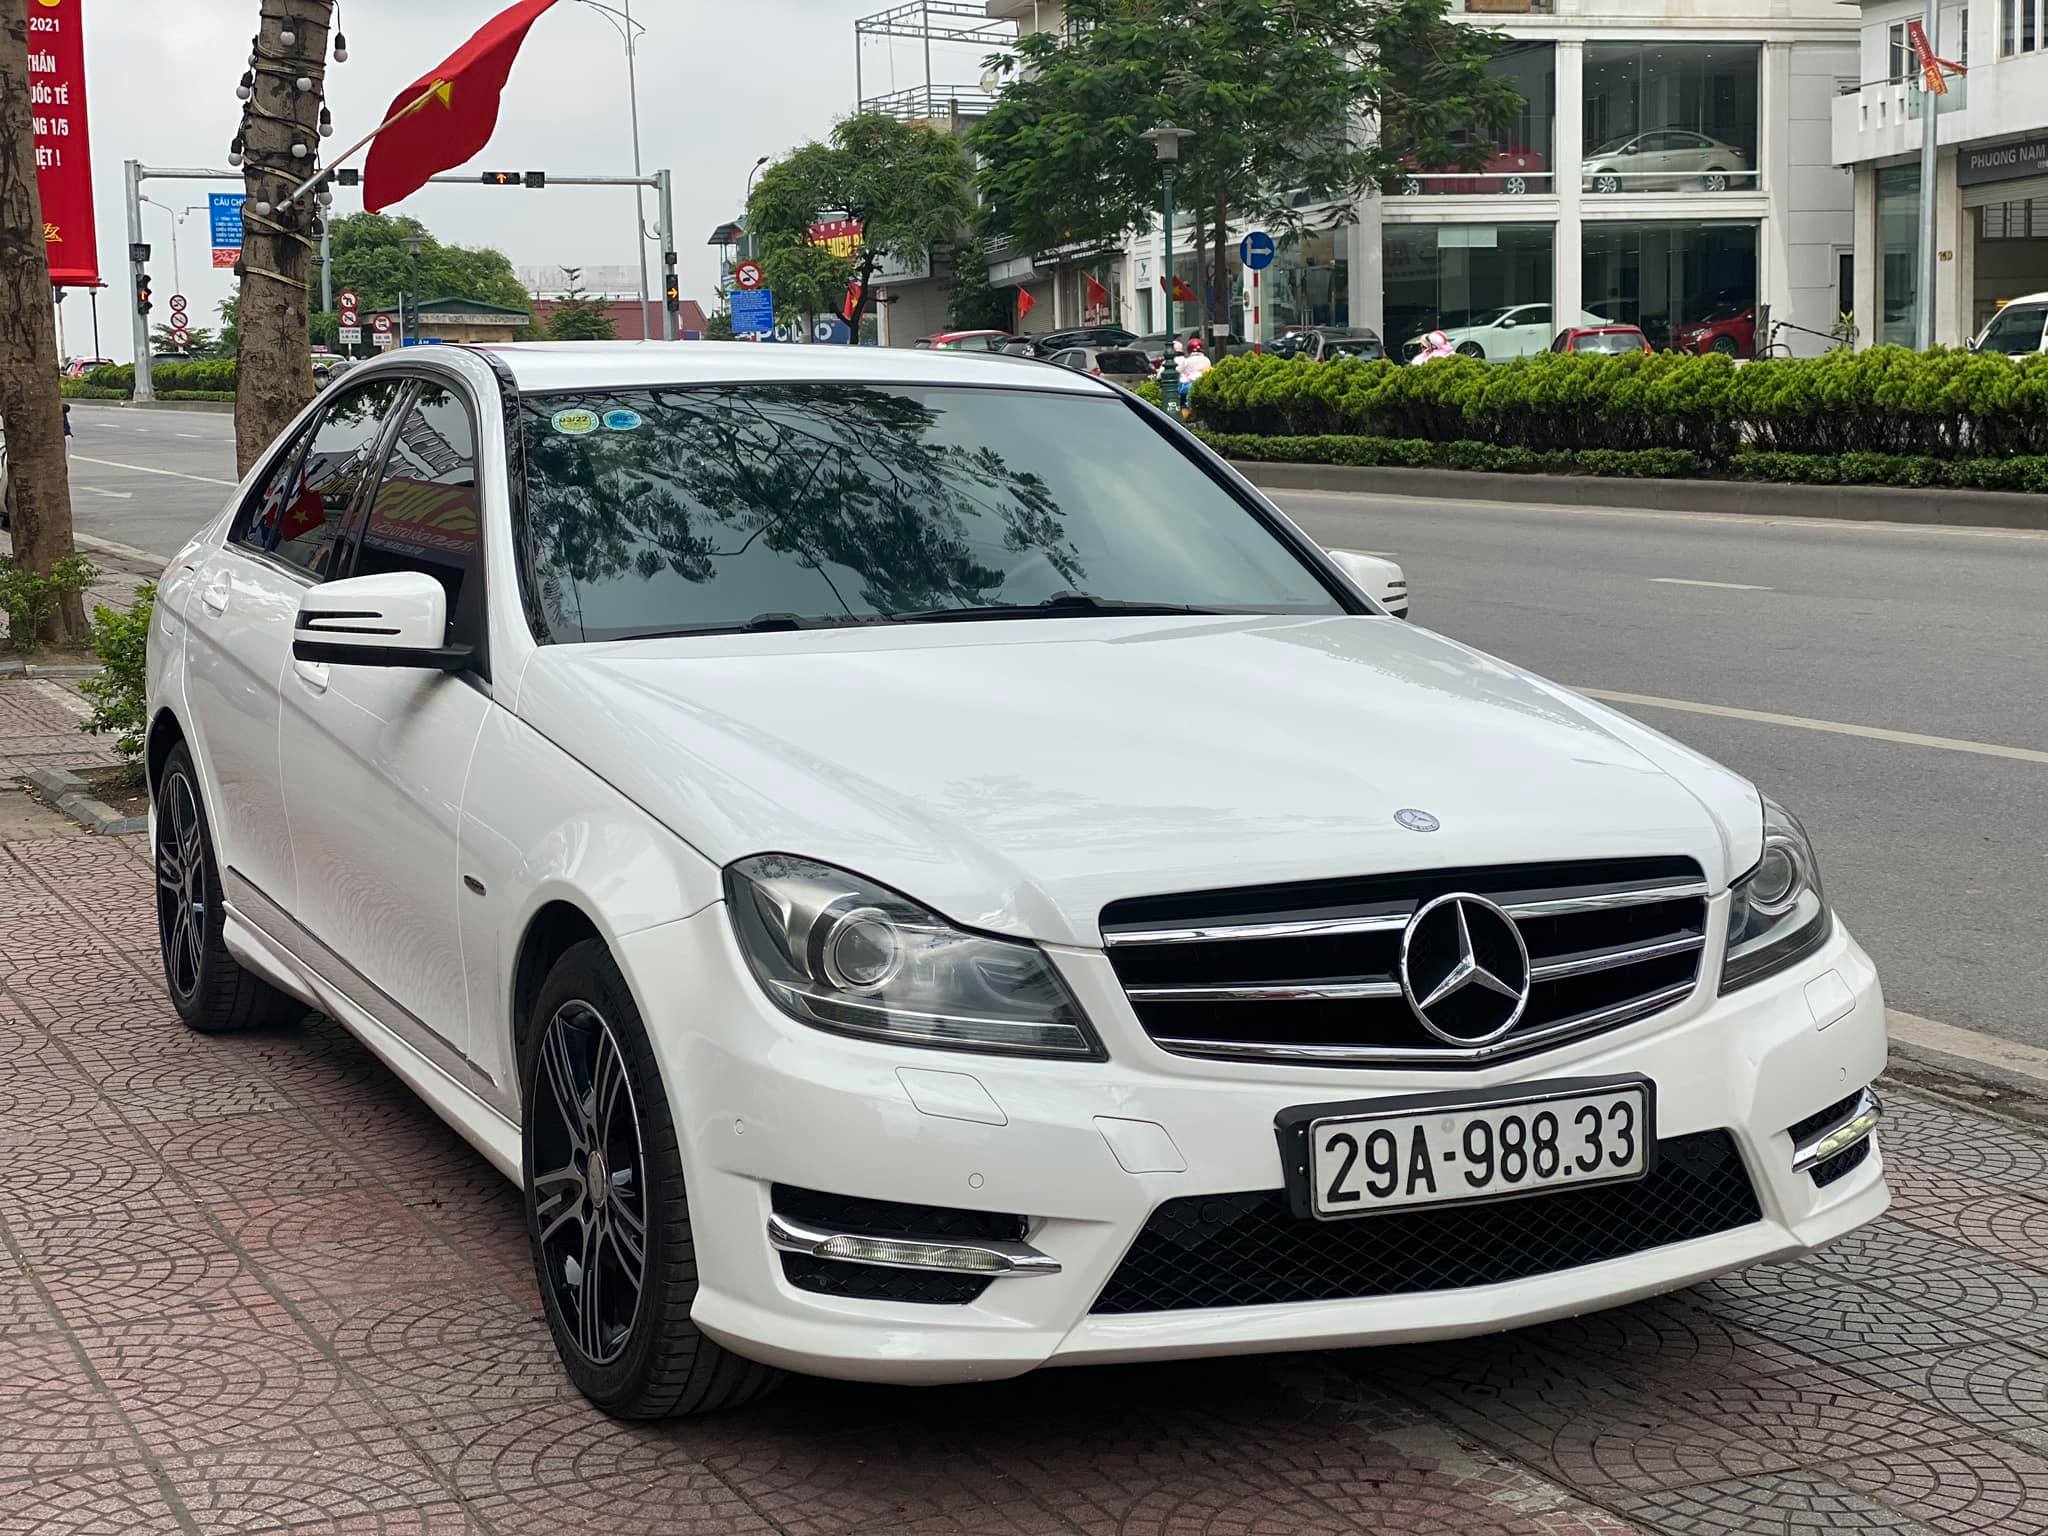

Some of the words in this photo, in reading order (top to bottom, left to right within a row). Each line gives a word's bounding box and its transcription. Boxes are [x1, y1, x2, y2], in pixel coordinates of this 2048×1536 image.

[29, 16, 59, 32] 2021
[31, 79, 53, 104] UỐC
[54, 81, 69, 105] TẾ
[50, 118, 69, 137] 1/5
[1970, 149, 2016, 169] PHUONG
[2019, 143, 2046, 161] NAM
[1324, 1100, 1636, 1204] 29A-988.33
